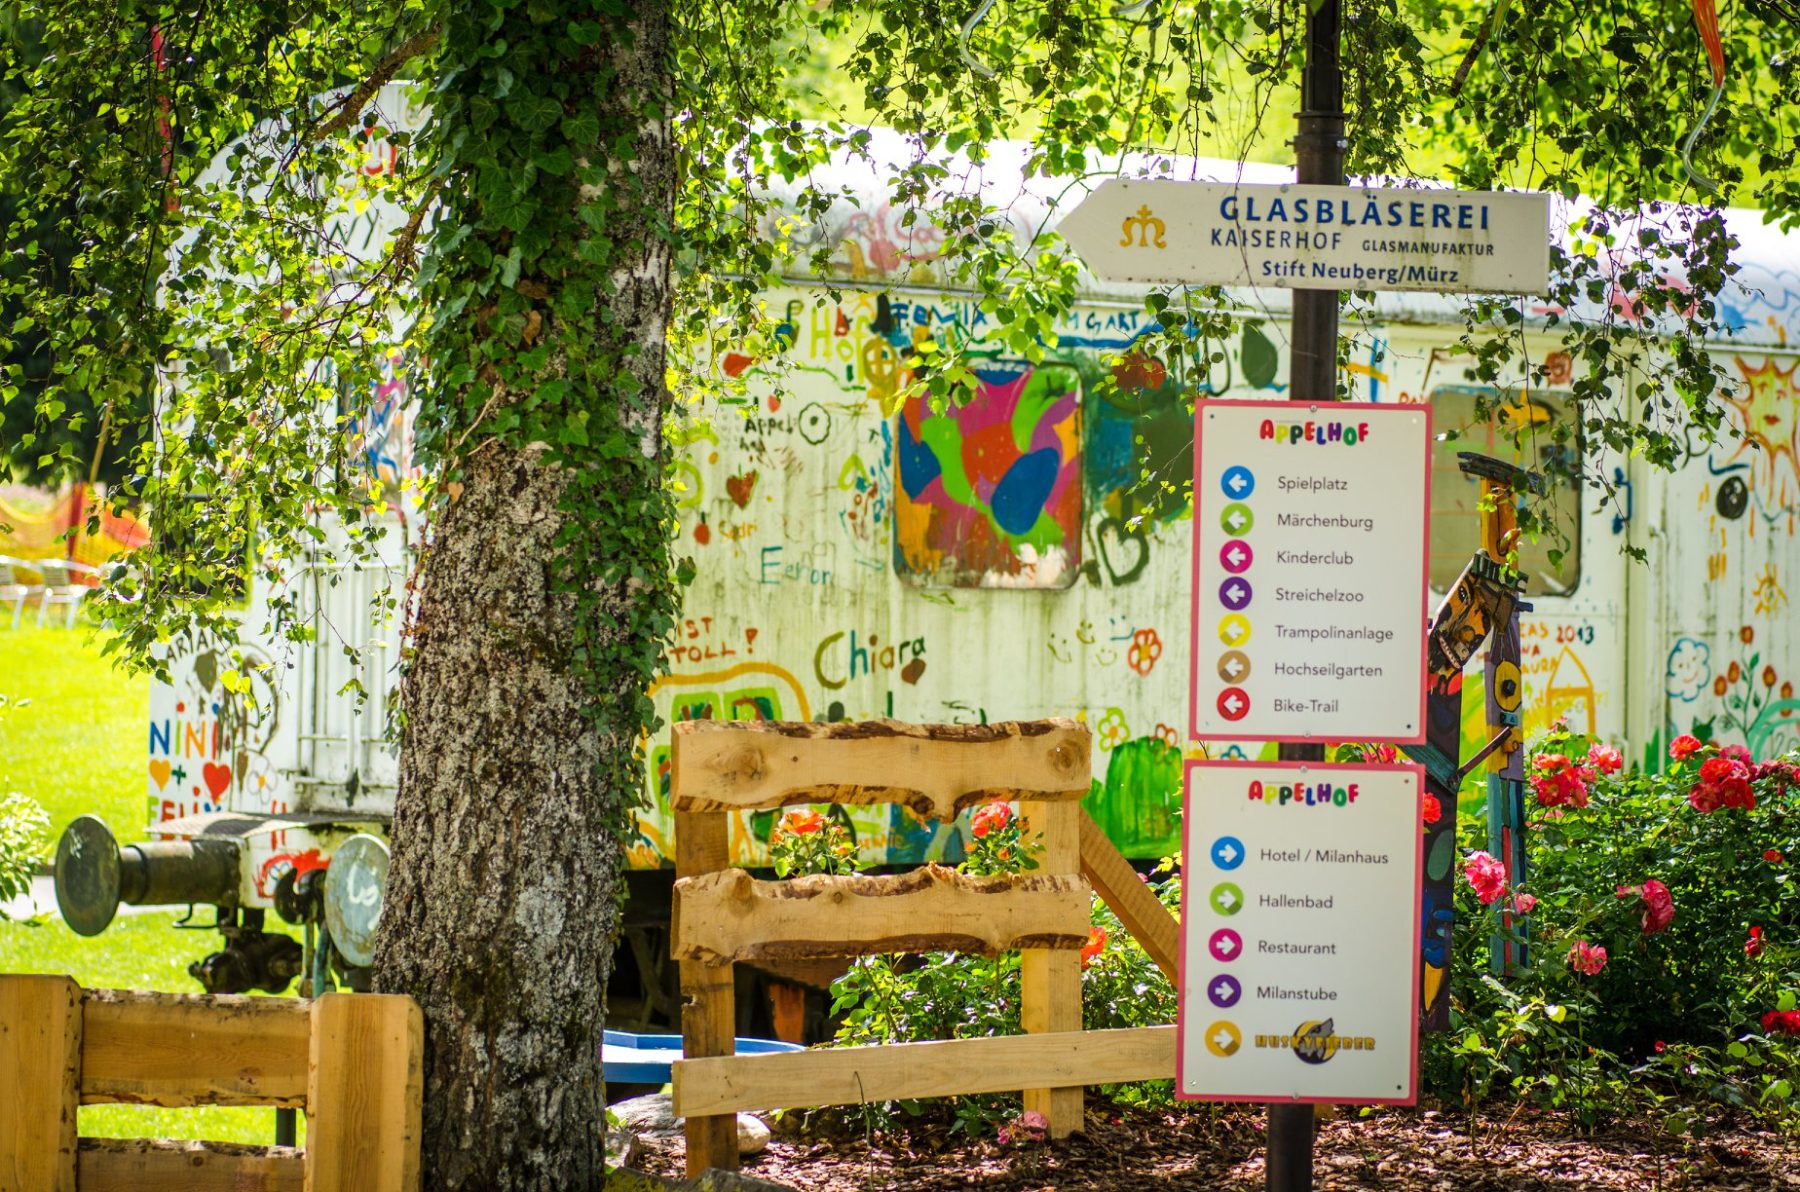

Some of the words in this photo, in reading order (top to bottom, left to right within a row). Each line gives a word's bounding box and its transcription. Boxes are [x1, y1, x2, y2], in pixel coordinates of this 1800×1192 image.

[1219, 194, 1490, 230] GLASBLÄSEREI
[1211, 228, 1342, 251] KAISERHOF
[1362, 239, 1494, 257] GLASMANUFAKTUR
[1262, 260, 1306, 278] Stift
[1311, 262, 1459, 284] Neuberg/Mürz
[1259, 419, 1369, 447] APPELHOF
[1277, 475, 1349, 493] Spielplatz
[1276, 512, 1374, 533] Märchenburg
[1276, 550, 1354, 566] Kinderclub
[1275, 587, 1365, 604] Streichelzoo
[1275, 624, 1395, 643] Trampolinanlage
[1556, 624, 1595, 645] 2013
[813, 629, 926, 691] Chiara
[1274, 662, 1383, 679] Hochseilgarten
[1273, 699, 1339, 714] Bike-Trail
[1248, 780, 1360, 807] APPELHOF
[1260, 848, 1301, 863] Hotel
[1315, 850, 1389, 864] Milanhaus
[1259, 894, 1334, 909] Hallenbad
[1258, 940, 1337, 955] Restaurant
[1256, 986, 1338, 1001] Milanstube
